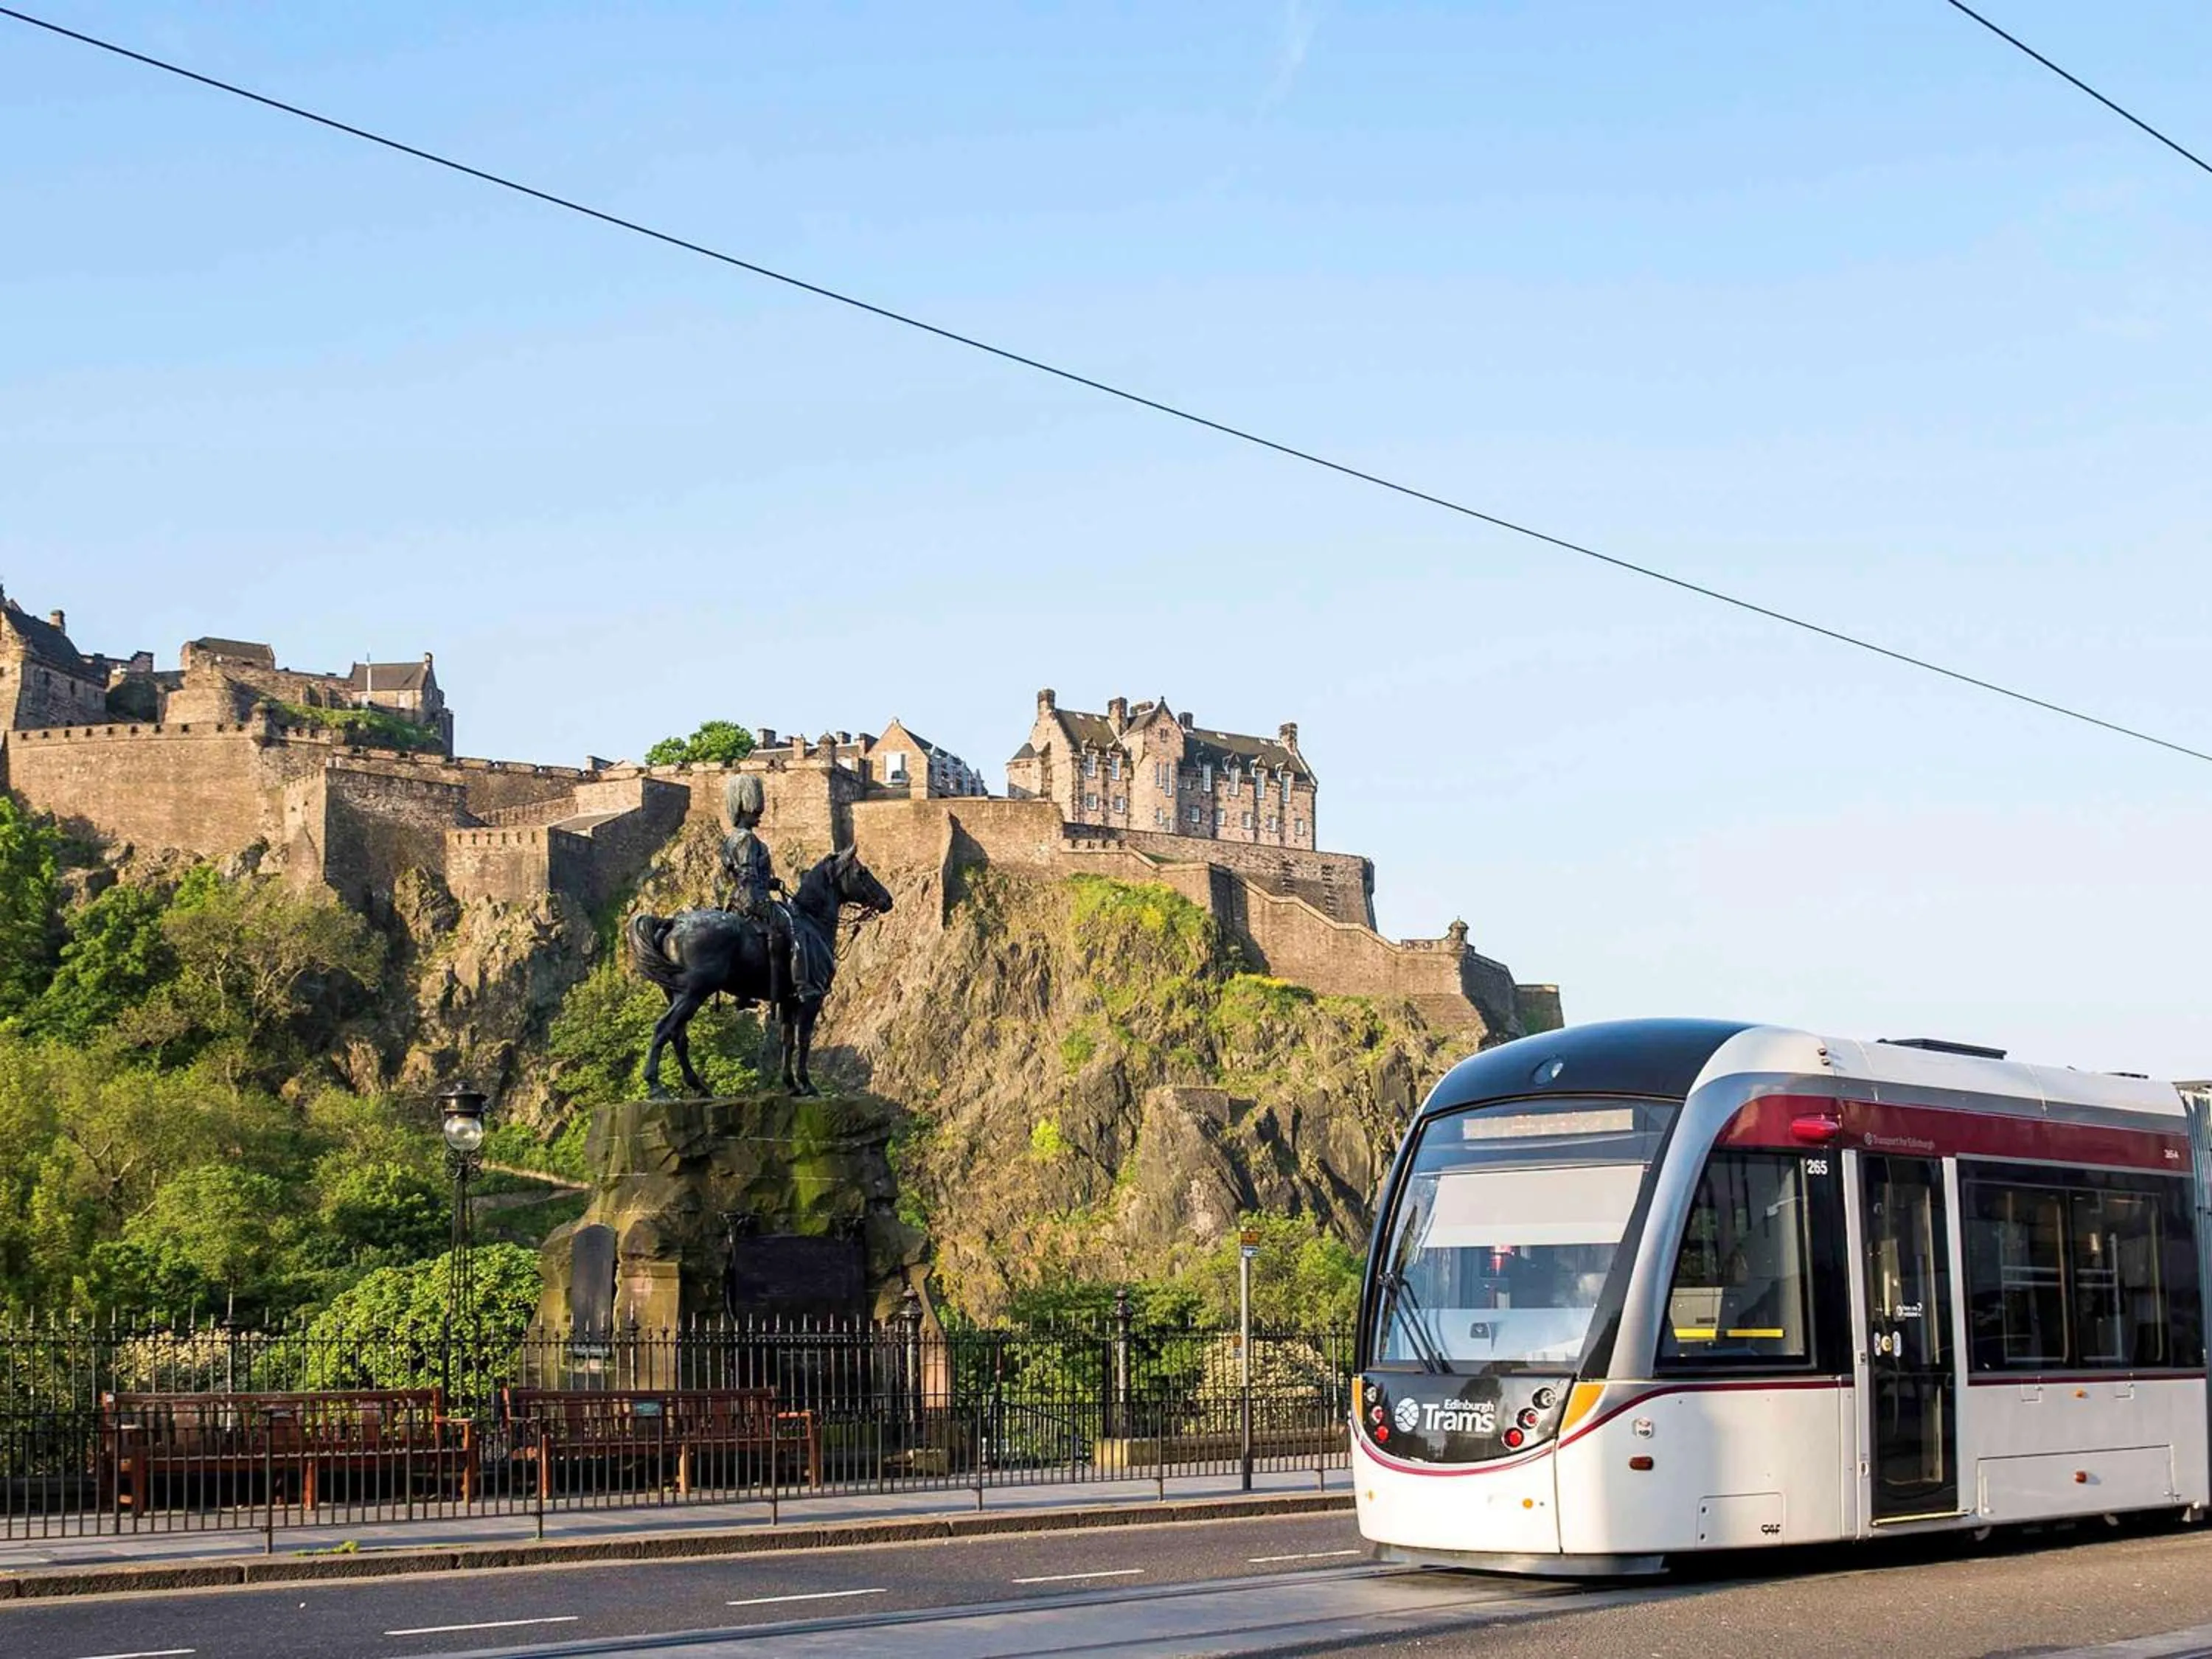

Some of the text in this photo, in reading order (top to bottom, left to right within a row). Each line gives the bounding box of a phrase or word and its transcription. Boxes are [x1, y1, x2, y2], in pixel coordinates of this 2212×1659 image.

[1806, 1158, 1828, 1175] 265
[1444, 1399, 1495, 1413] Edinburgh
[1422, 1403, 1495, 1433] Trams
